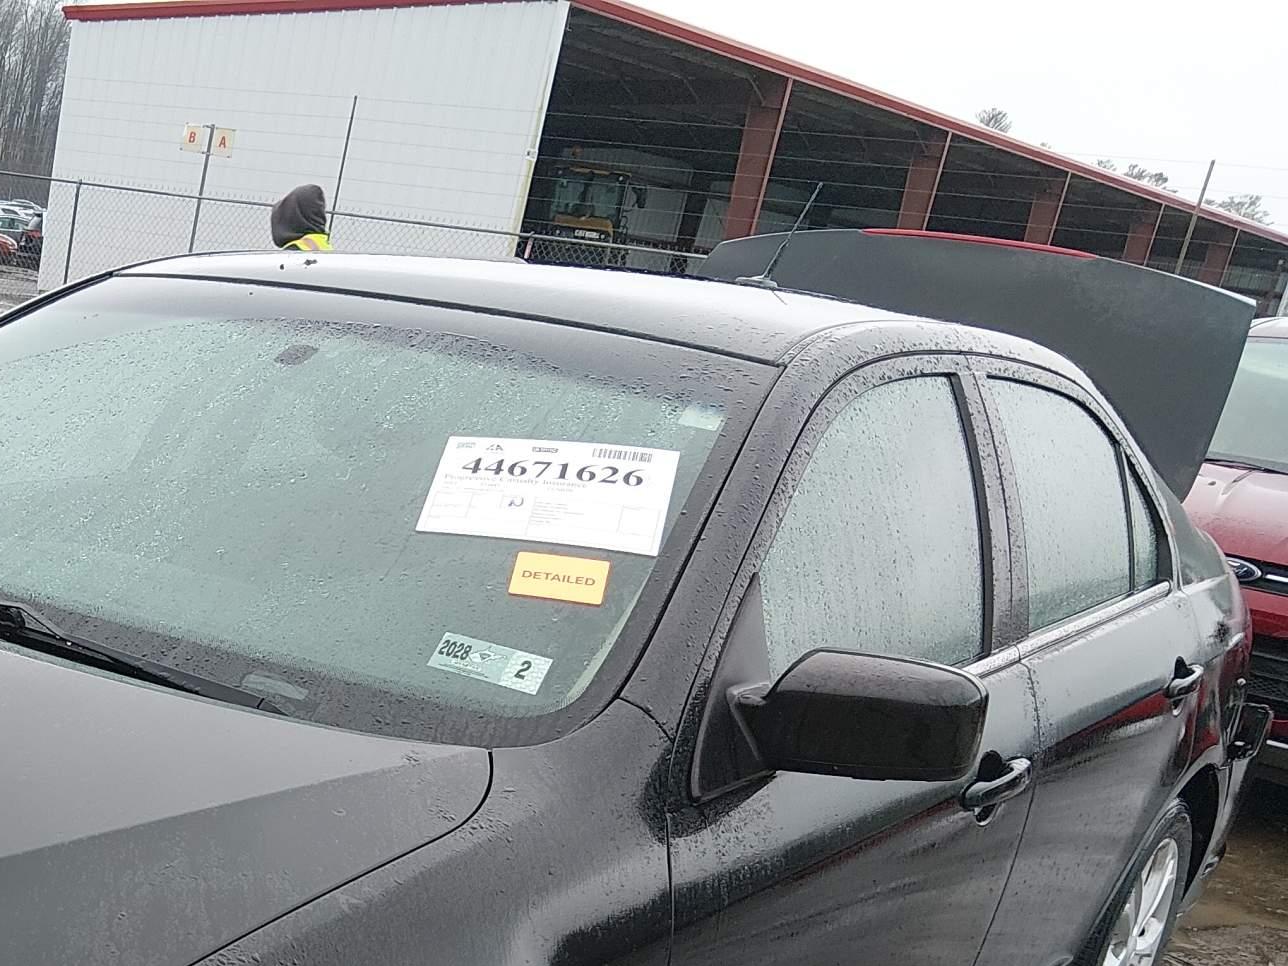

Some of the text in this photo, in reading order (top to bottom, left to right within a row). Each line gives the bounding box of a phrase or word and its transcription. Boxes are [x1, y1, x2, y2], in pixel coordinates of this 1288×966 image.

[188, 131, 197, 143] B
[218, 136, 226, 149] A
[461, 456, 645, 487] 44671626
[521, 570, 596, 587] DETAILED
[437, 639, 473, 661] 2028
[514, 660, 532, 680] 2
